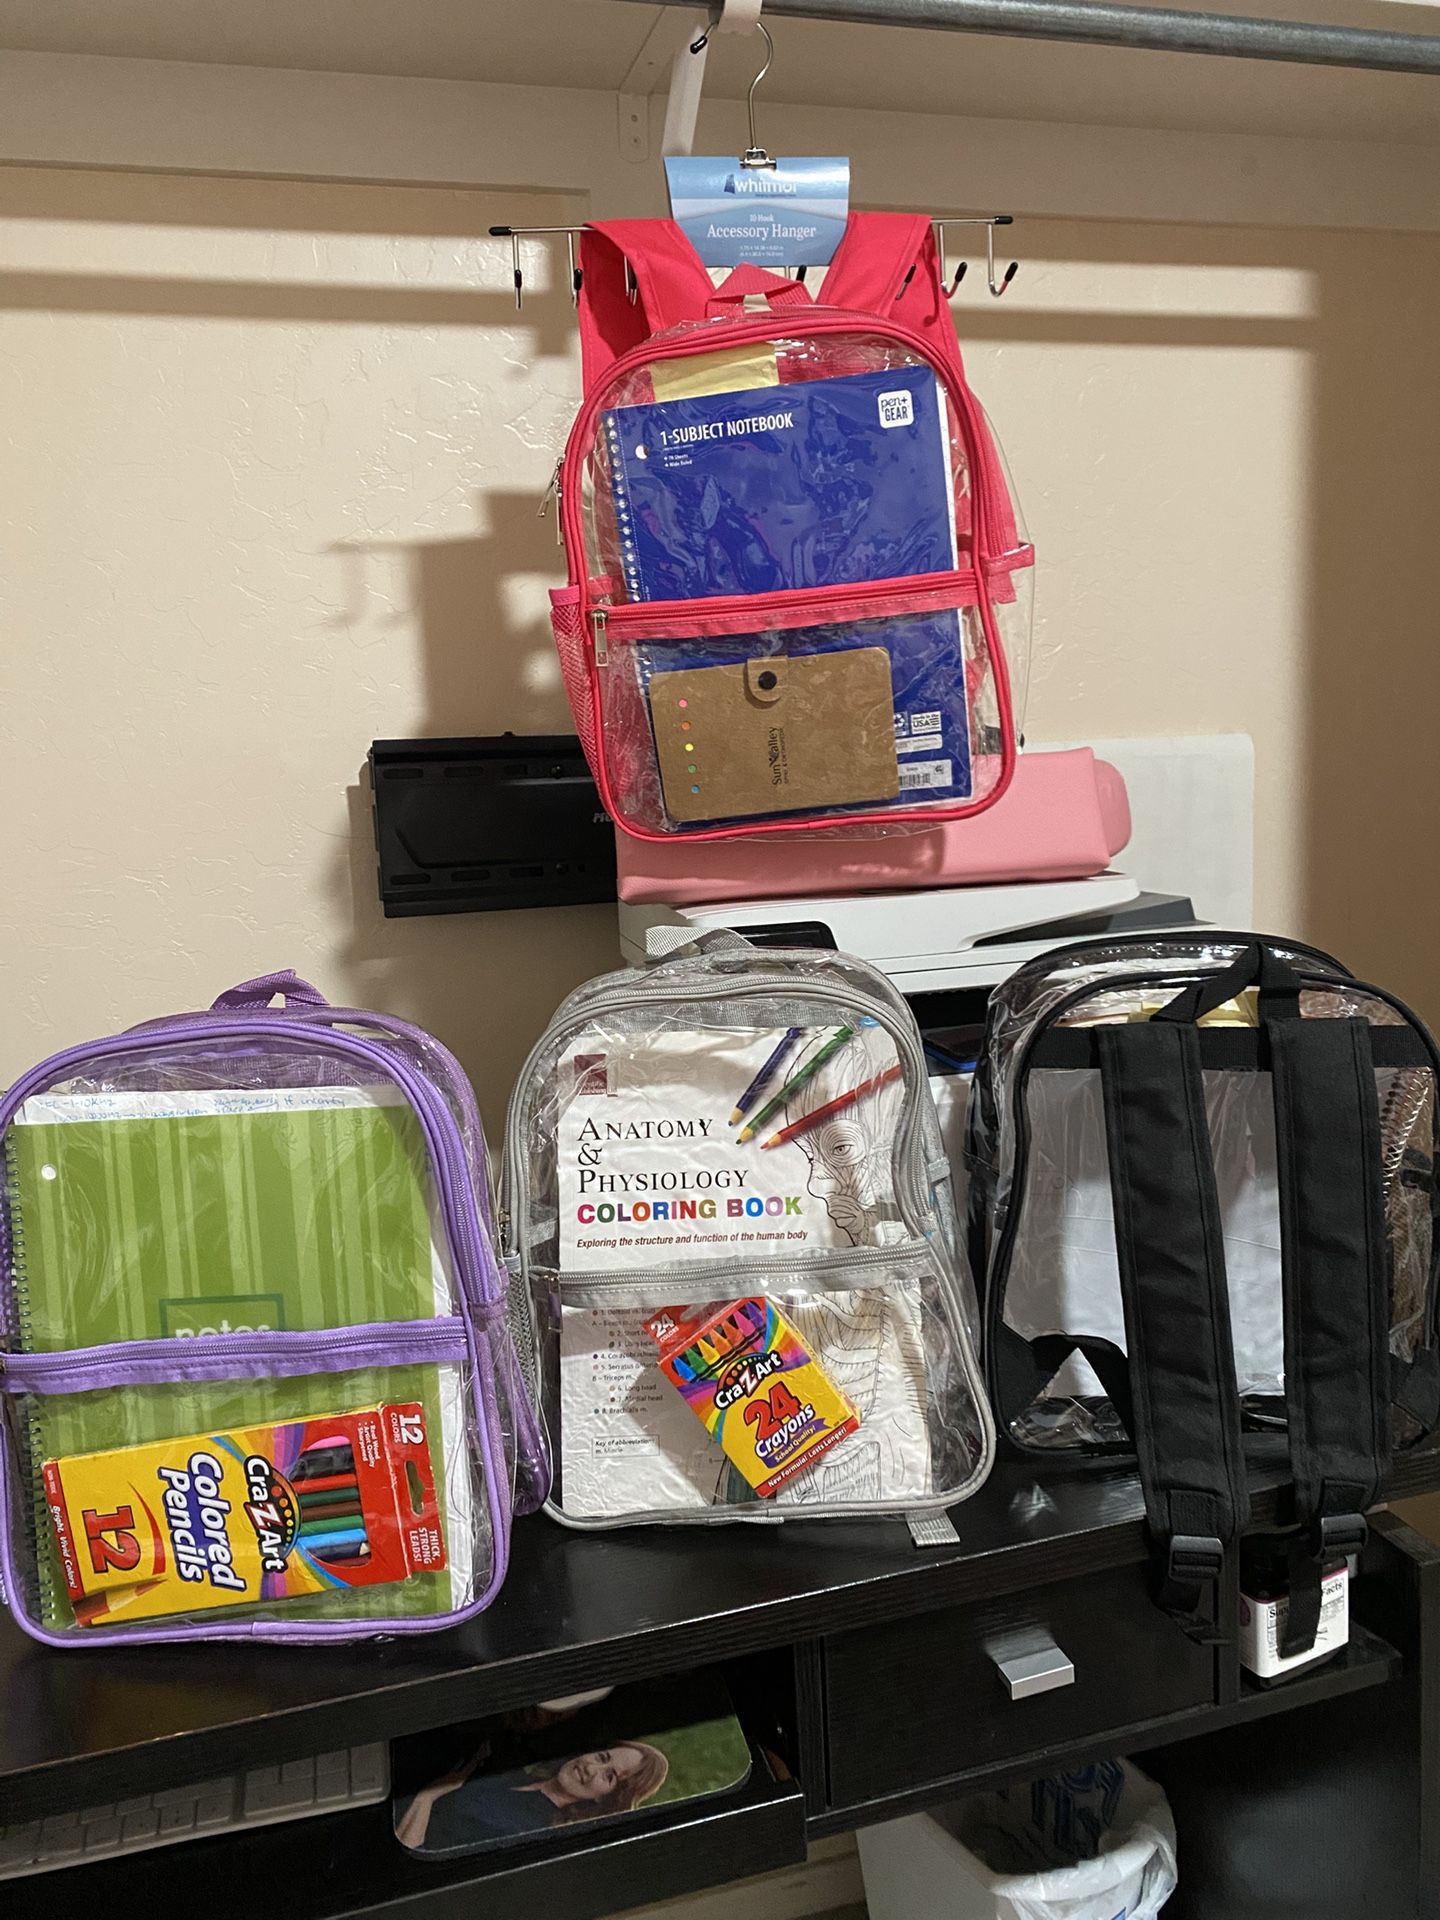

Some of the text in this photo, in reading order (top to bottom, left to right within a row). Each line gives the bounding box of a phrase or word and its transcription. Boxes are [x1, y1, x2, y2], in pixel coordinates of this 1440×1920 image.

[707, 224, 816, 241] Accessory Hanger
[660, 412, 794, 446] 1-SUBJECT NOTEBOOK
[885, 406, 908, 421] GEAR
[913, 719, 930, 728] USA
[771, 764, 783, 785] Sun
[577, 1117, 713, 1142] ANATOMY
[577, 1143, 602, 1166] &
[578, 1169, 749, 1194] PHYSIOLOGY
[577, 1196, 803, 1224] COLORING BOOK
[576, 1230, 808, 1248] Exploring the structure and function of the human body
[650, 1313, 675, 1338] 24
[744, 1381, 801, 1440] 24
[370, 1425, 381, 1460] Real Wood
[389, 1412, 402, 1444] COLORS
[399, 1413, 424, 1445] 12
[756, 1403, 815, 1458] Crayons
[775, 1425, 816, 1463] School Quality!
[357, 1427, 368, 1462] Sharpened
[367, 1444, 375, 1468] Quality
[768, 1426, 847, 1488] New Formula! Lasts Longer!
[159, 1468, 207, 1580] Pencils
[190, 1452, 246, 1589] Colored
[59, 1536, 71, 1558] Vivid
[82, 1505, 141, 1574] 12
[409, 1530, 422, 1562] LEADS!
[418, 1527, 432, 1564] STRONG
[429, 1529, 441, 1562] THICK,
[64, 1560, 77, 1589] Colors!
